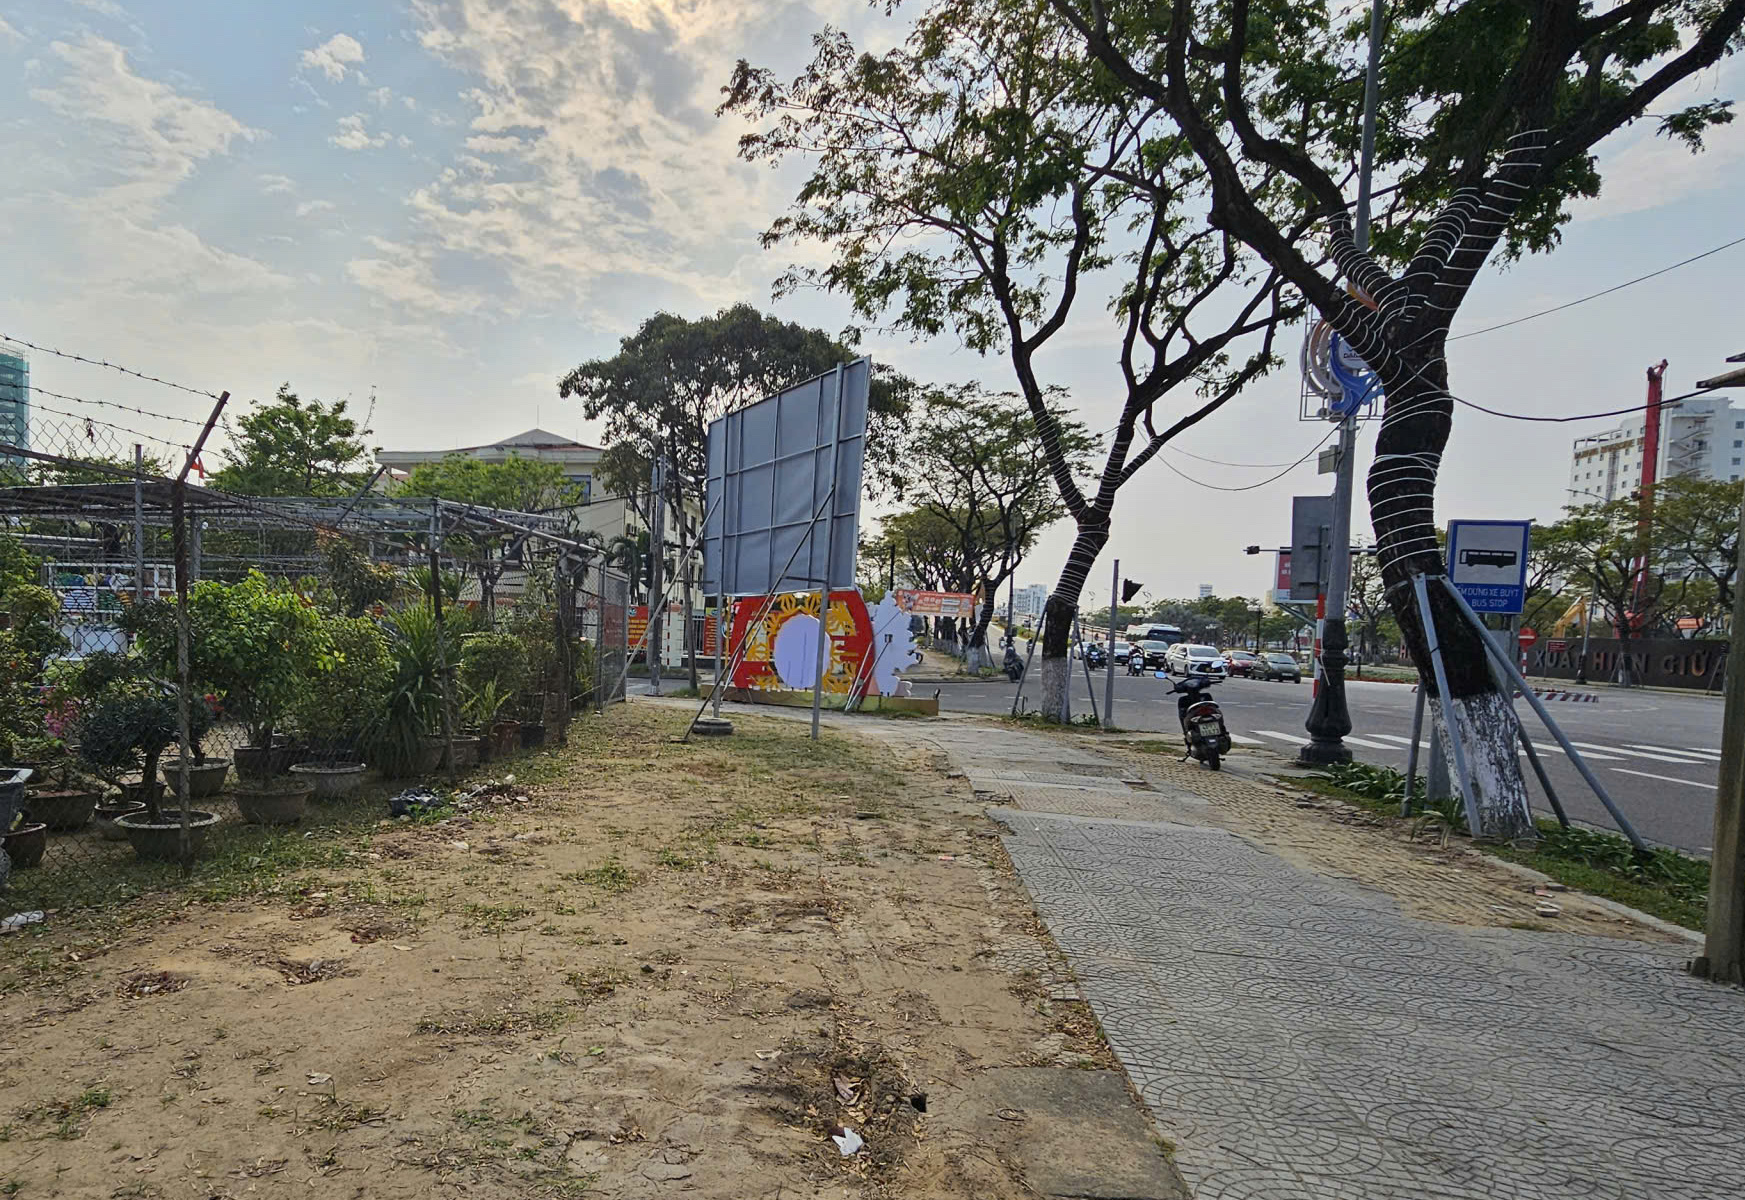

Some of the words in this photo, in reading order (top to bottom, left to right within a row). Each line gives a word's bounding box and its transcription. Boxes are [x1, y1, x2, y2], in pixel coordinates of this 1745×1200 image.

[1489, 588, 1498, 596] XE
[1472, 599, 1487, 607] BUS
[1489, 599, 1508, 607] STOP
